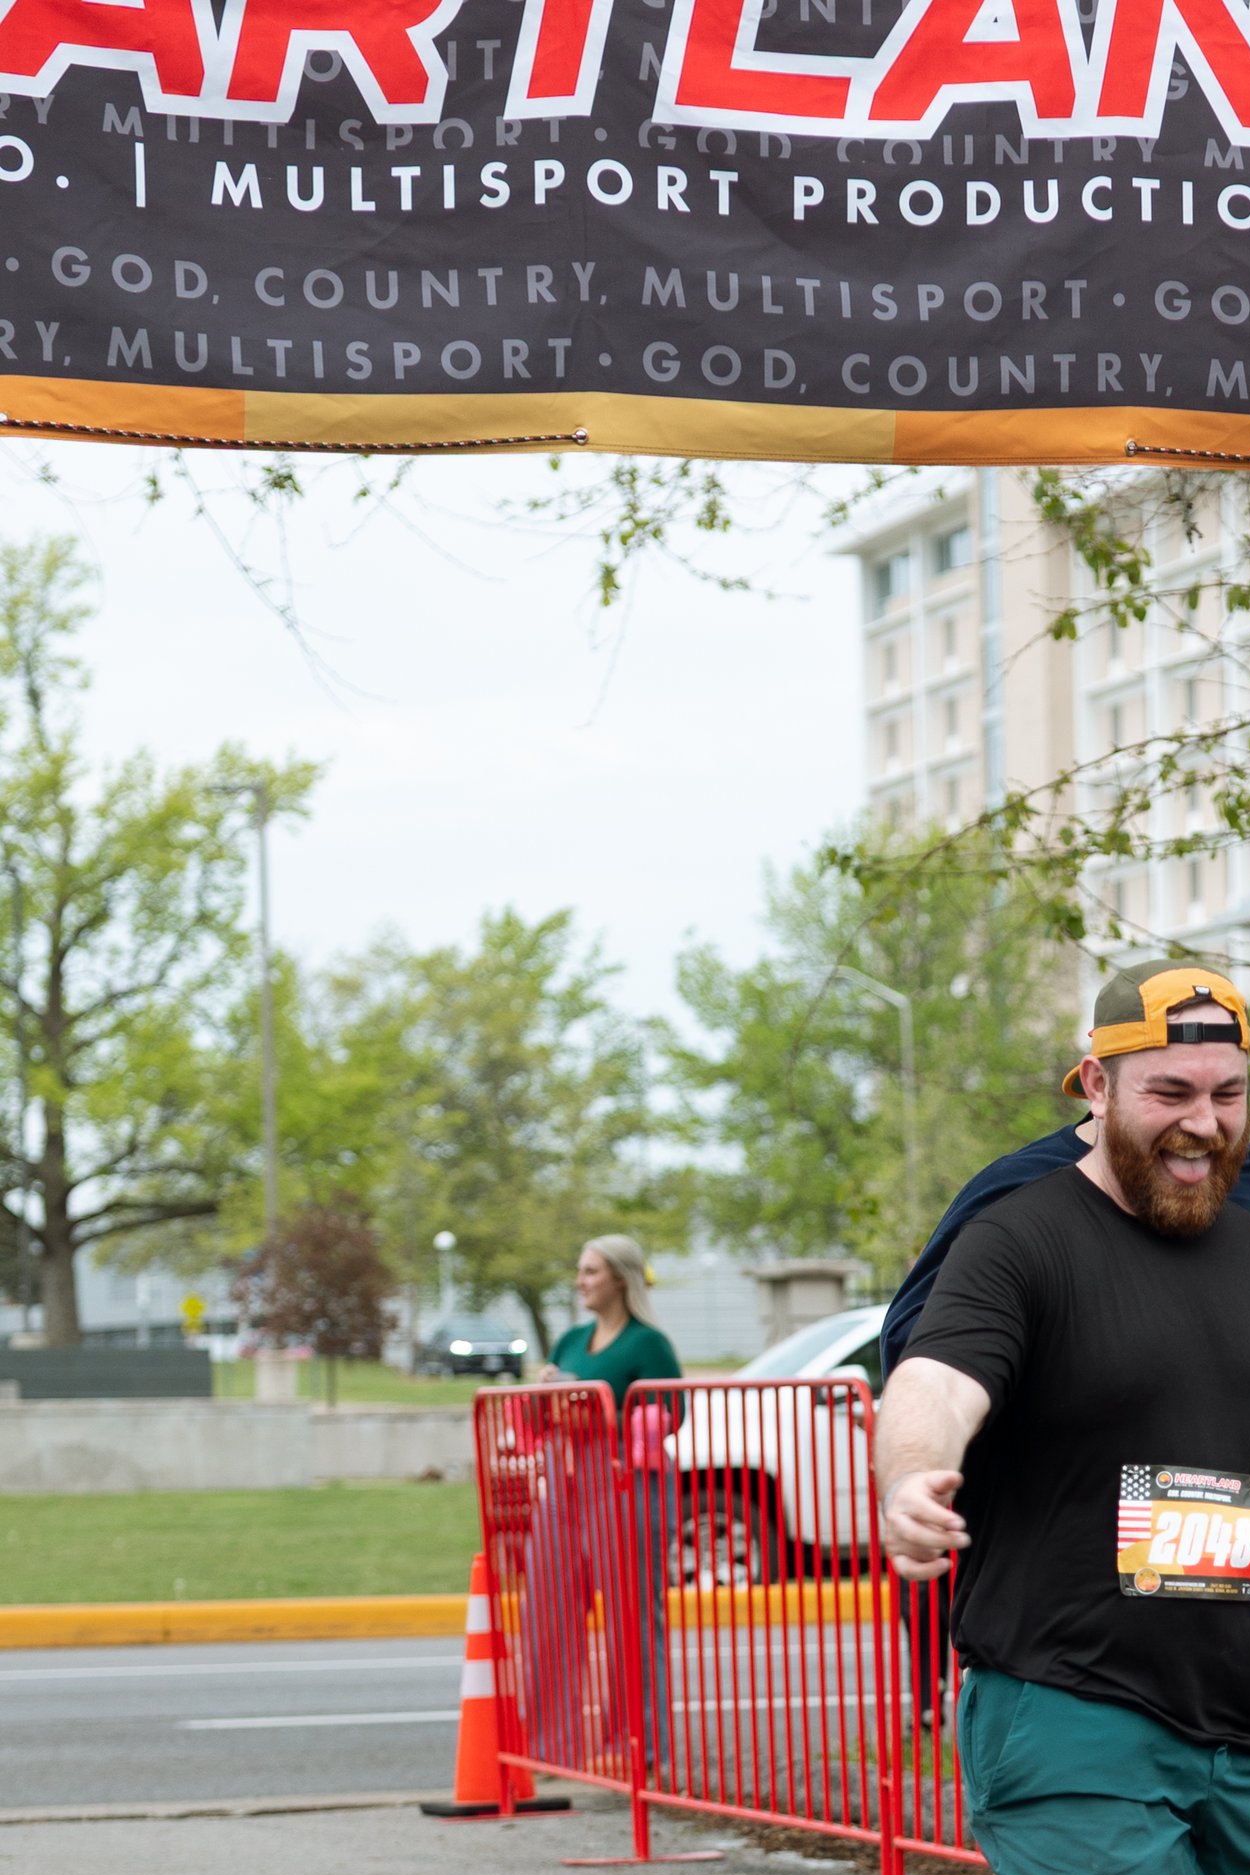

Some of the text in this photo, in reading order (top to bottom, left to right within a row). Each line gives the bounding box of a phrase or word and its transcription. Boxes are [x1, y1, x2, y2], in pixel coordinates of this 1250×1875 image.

[211, 158, 739, 216] MULTISPORT
[51, 246, 220, 305] GOD,
[255, 261, 608, 309] COUNTRY,
[642, 266, 1090, 322] MULTISPORT
[106, 326, 573, 380] MULTISPORT
[643, 341, 807, 395] GOD,
[841, 352, 1172, 398] COUNTRY,
